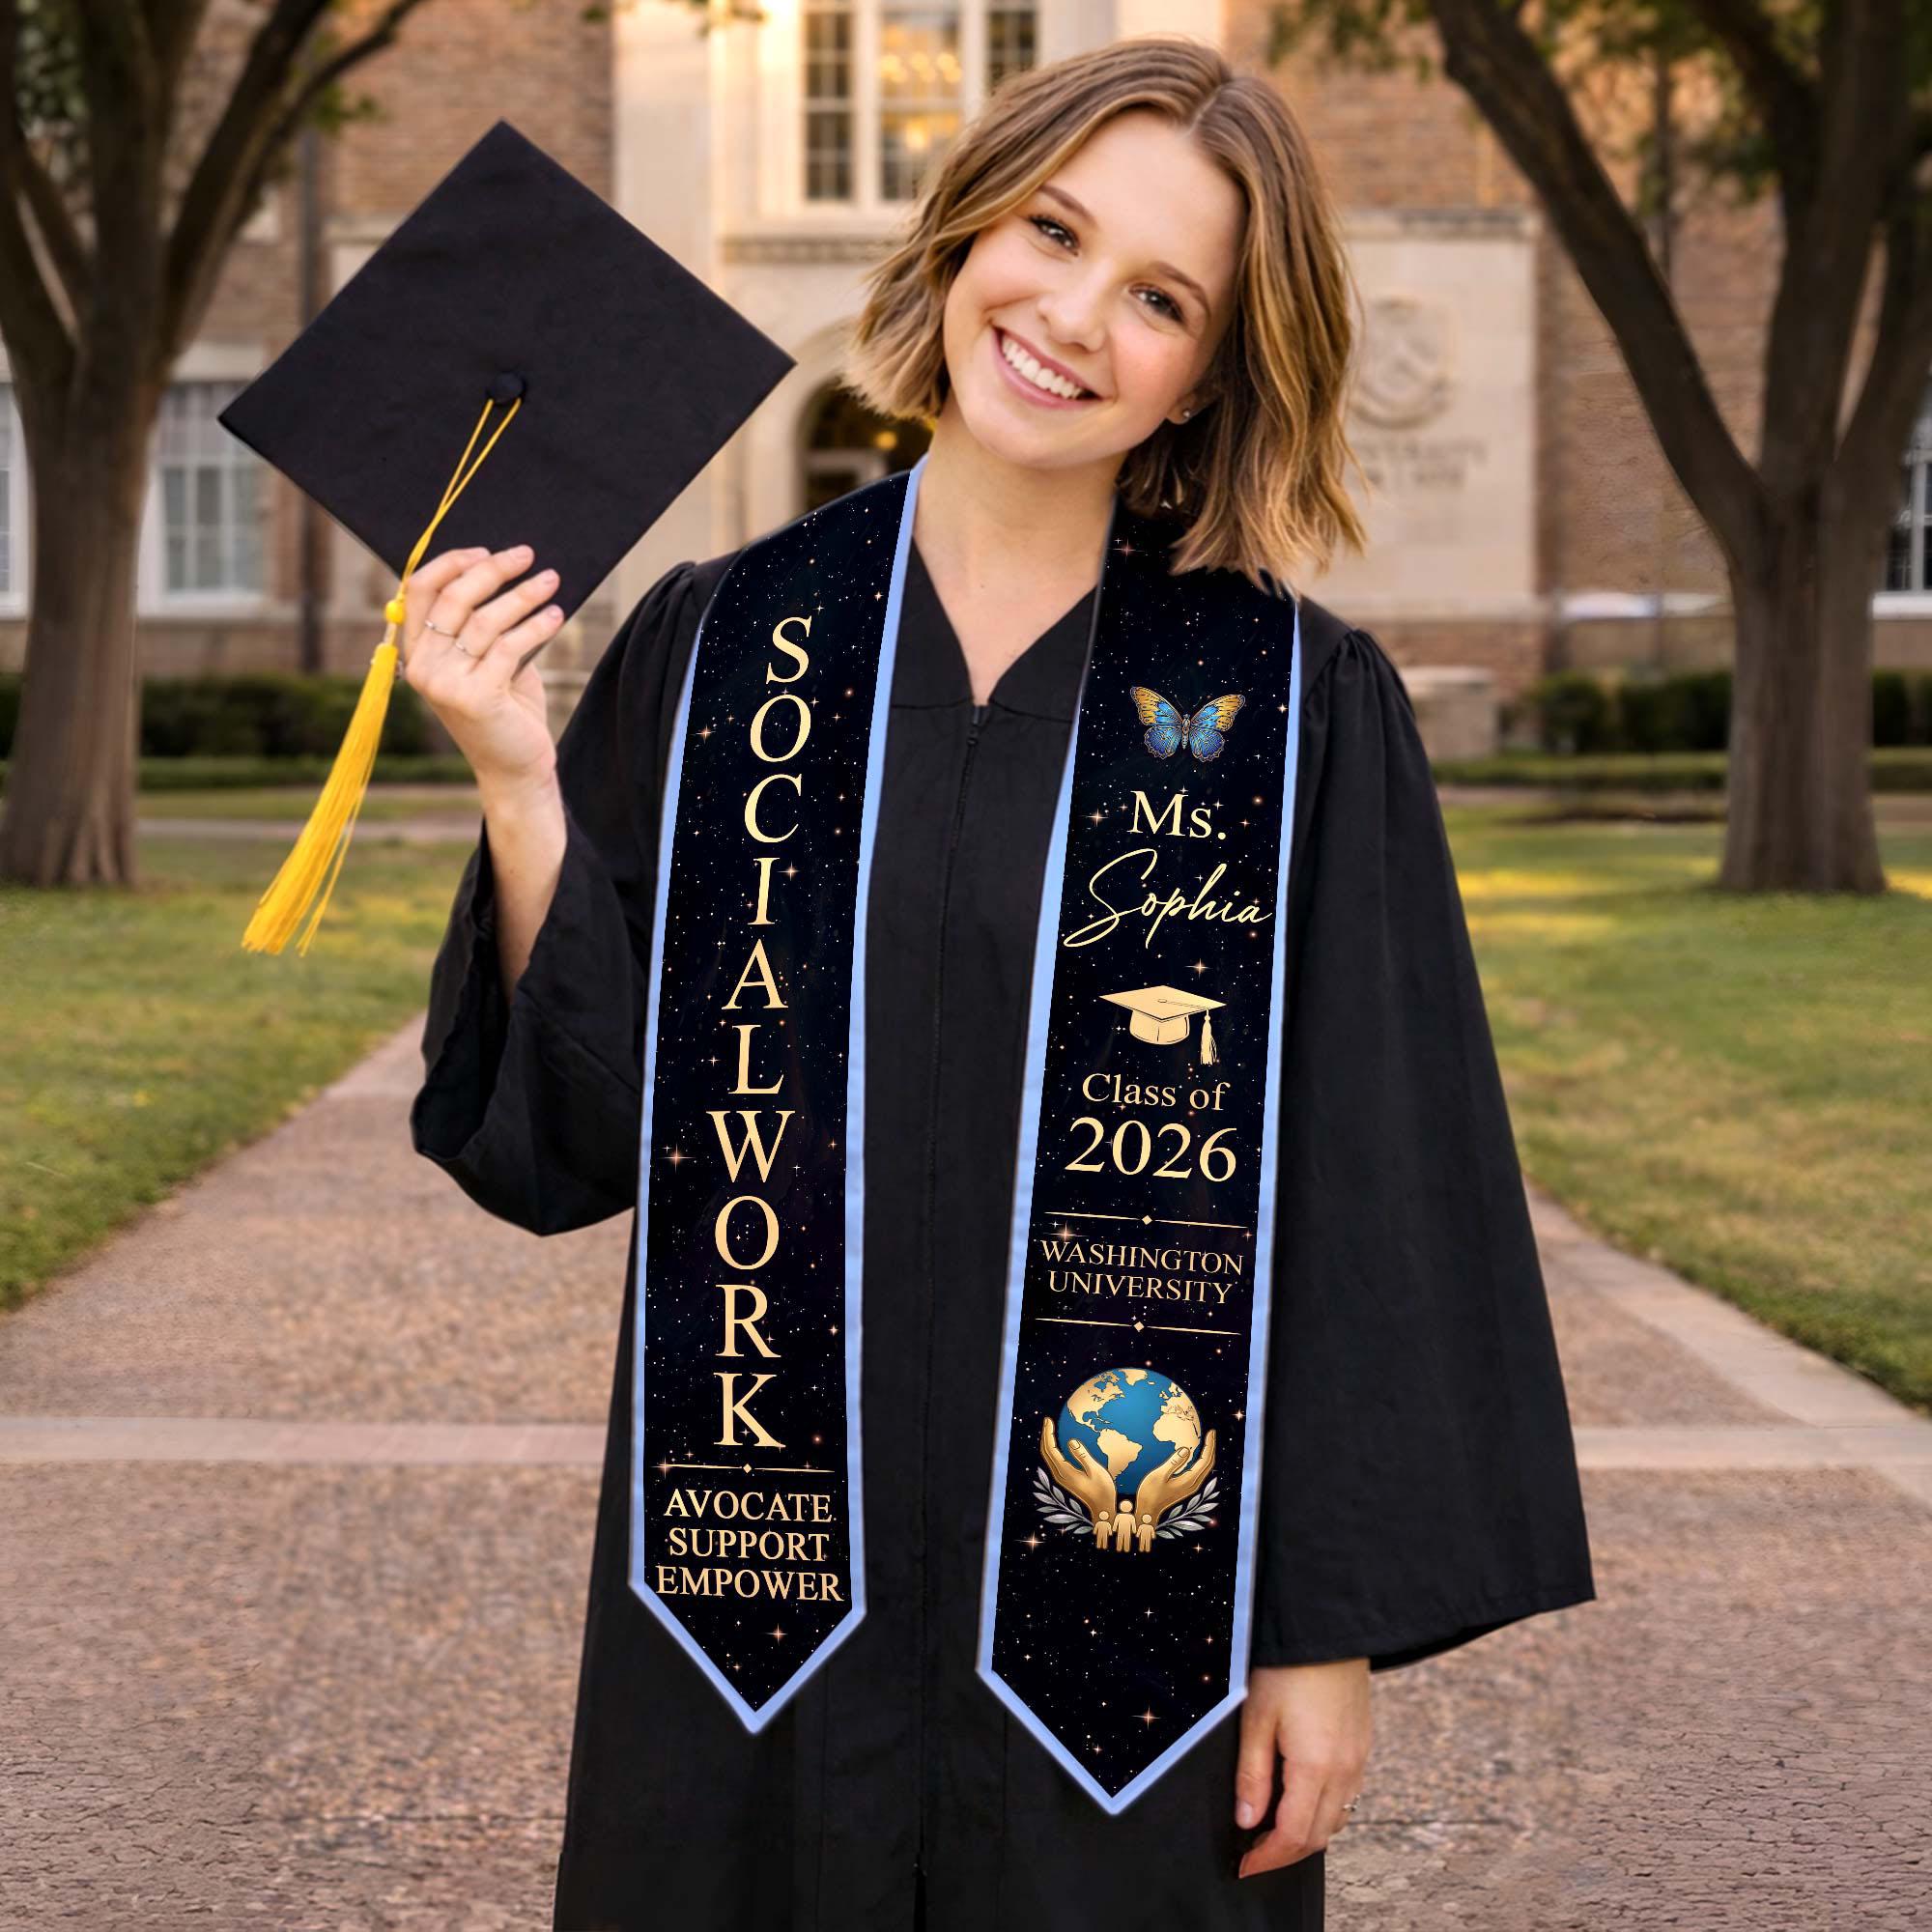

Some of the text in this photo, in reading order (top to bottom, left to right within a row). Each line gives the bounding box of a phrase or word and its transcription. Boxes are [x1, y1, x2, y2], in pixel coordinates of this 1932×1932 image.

[1126, 790, 1226, 839] Ms.
[1063, 848, 1273, 949] Sophia
[1082, 1073, 1231, 1111] Class of
[1065, 1117, 1237, 1181] 2026
[1039, 1239, 1243, 1275] WASHINGTON
[1047, 1270, 1234, 1303] UNIVERSITY
[663, 1489, 832, 1522] AVOCATE
[668, 1527, 830, 1561] SUPPORT
[655, 1565, 845, 1601] EMPOWER
